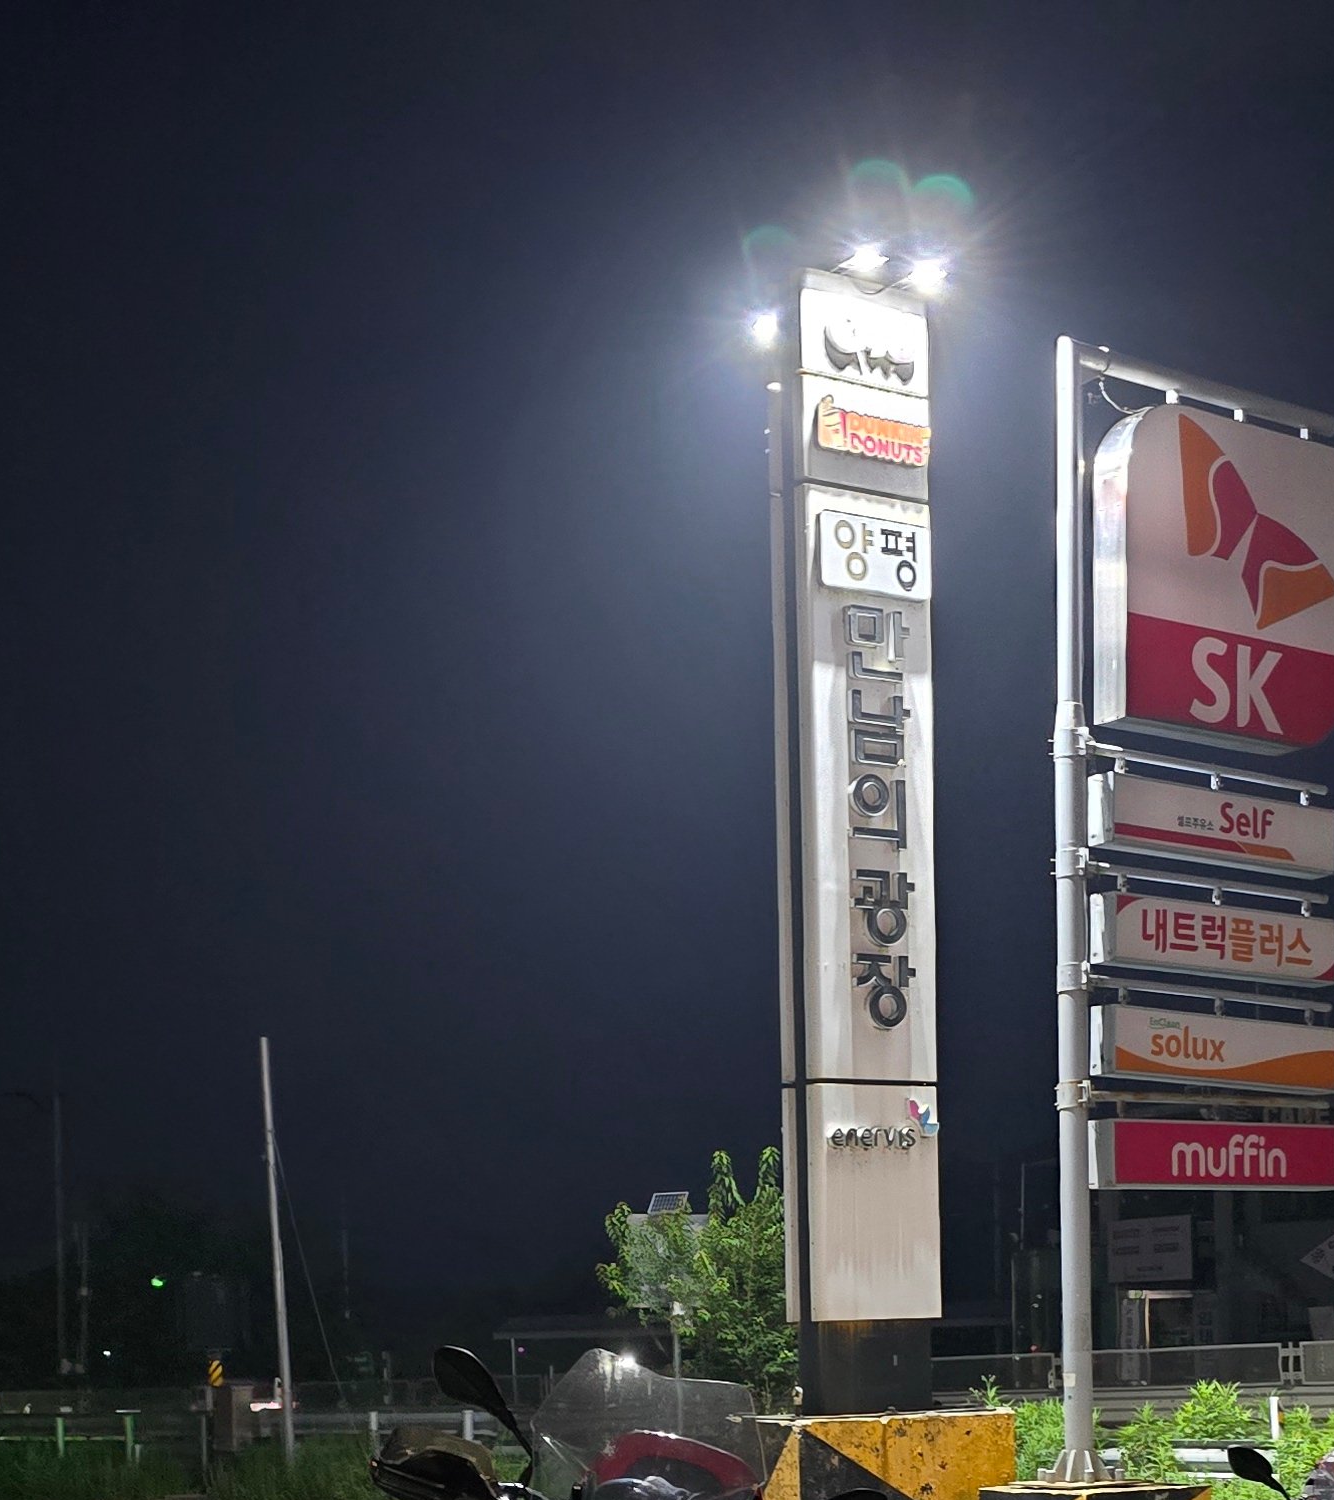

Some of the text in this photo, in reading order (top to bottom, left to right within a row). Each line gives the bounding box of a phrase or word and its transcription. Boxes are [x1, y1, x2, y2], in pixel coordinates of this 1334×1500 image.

[850, 432, 923, 464] DONUTS
[834, 519, 917, 592] 양평
[1189, 636, 1284, 735] SK
[1219, 801, 1275, 840] Self
[1141, 908, 1313, 968] 내트럭플러스
[1150, 1026, 1225, 1063] solux
[830, 1125, 917, 1149] enervis
[1171, 1134, 1287, 1178] muffin
